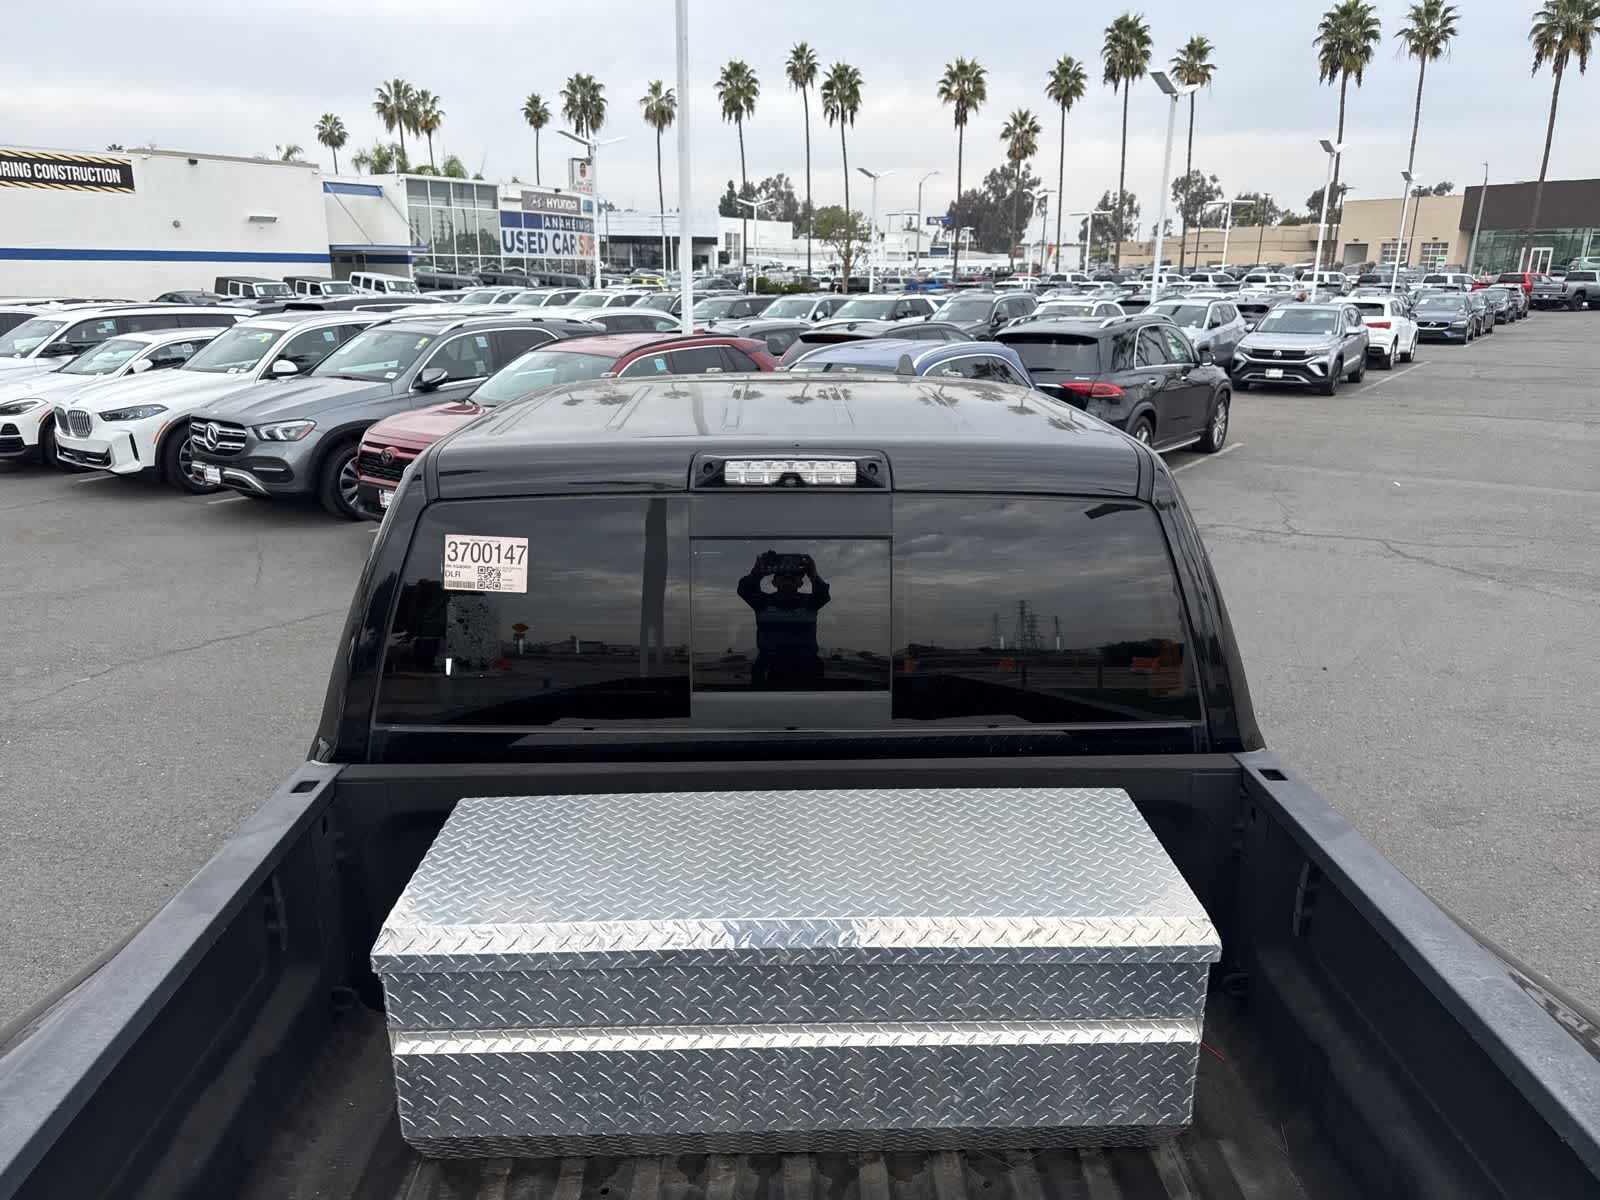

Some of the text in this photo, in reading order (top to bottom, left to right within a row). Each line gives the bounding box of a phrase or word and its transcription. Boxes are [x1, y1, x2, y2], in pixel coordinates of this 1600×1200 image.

[0, 161, 121, 184] RING CONSTRUCTION
[502, 230, 548, 255] USED
[447, 541, 528, 565] 3700147
